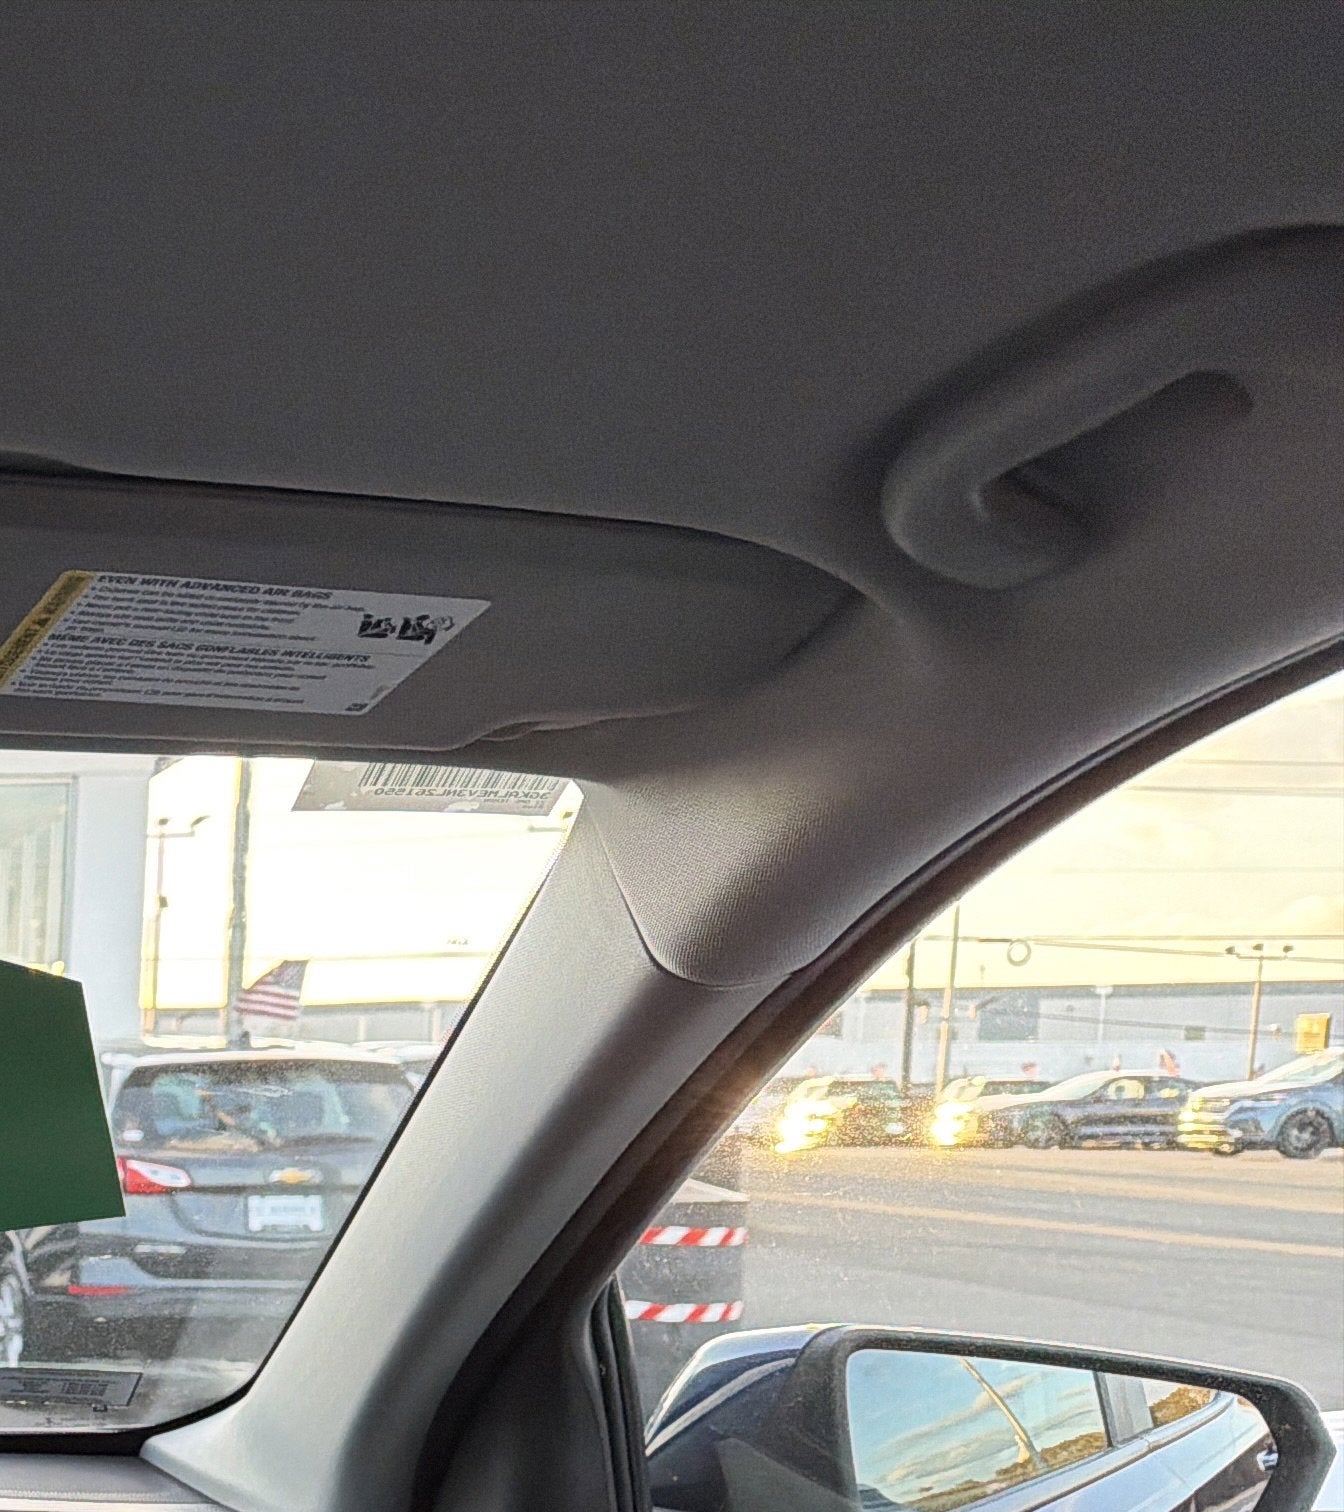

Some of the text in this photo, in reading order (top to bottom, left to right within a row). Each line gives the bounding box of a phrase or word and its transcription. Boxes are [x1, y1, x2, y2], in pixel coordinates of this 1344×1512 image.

[97, 574, 334, 600] EVEN WITH ADVANCED AIR BAGS
